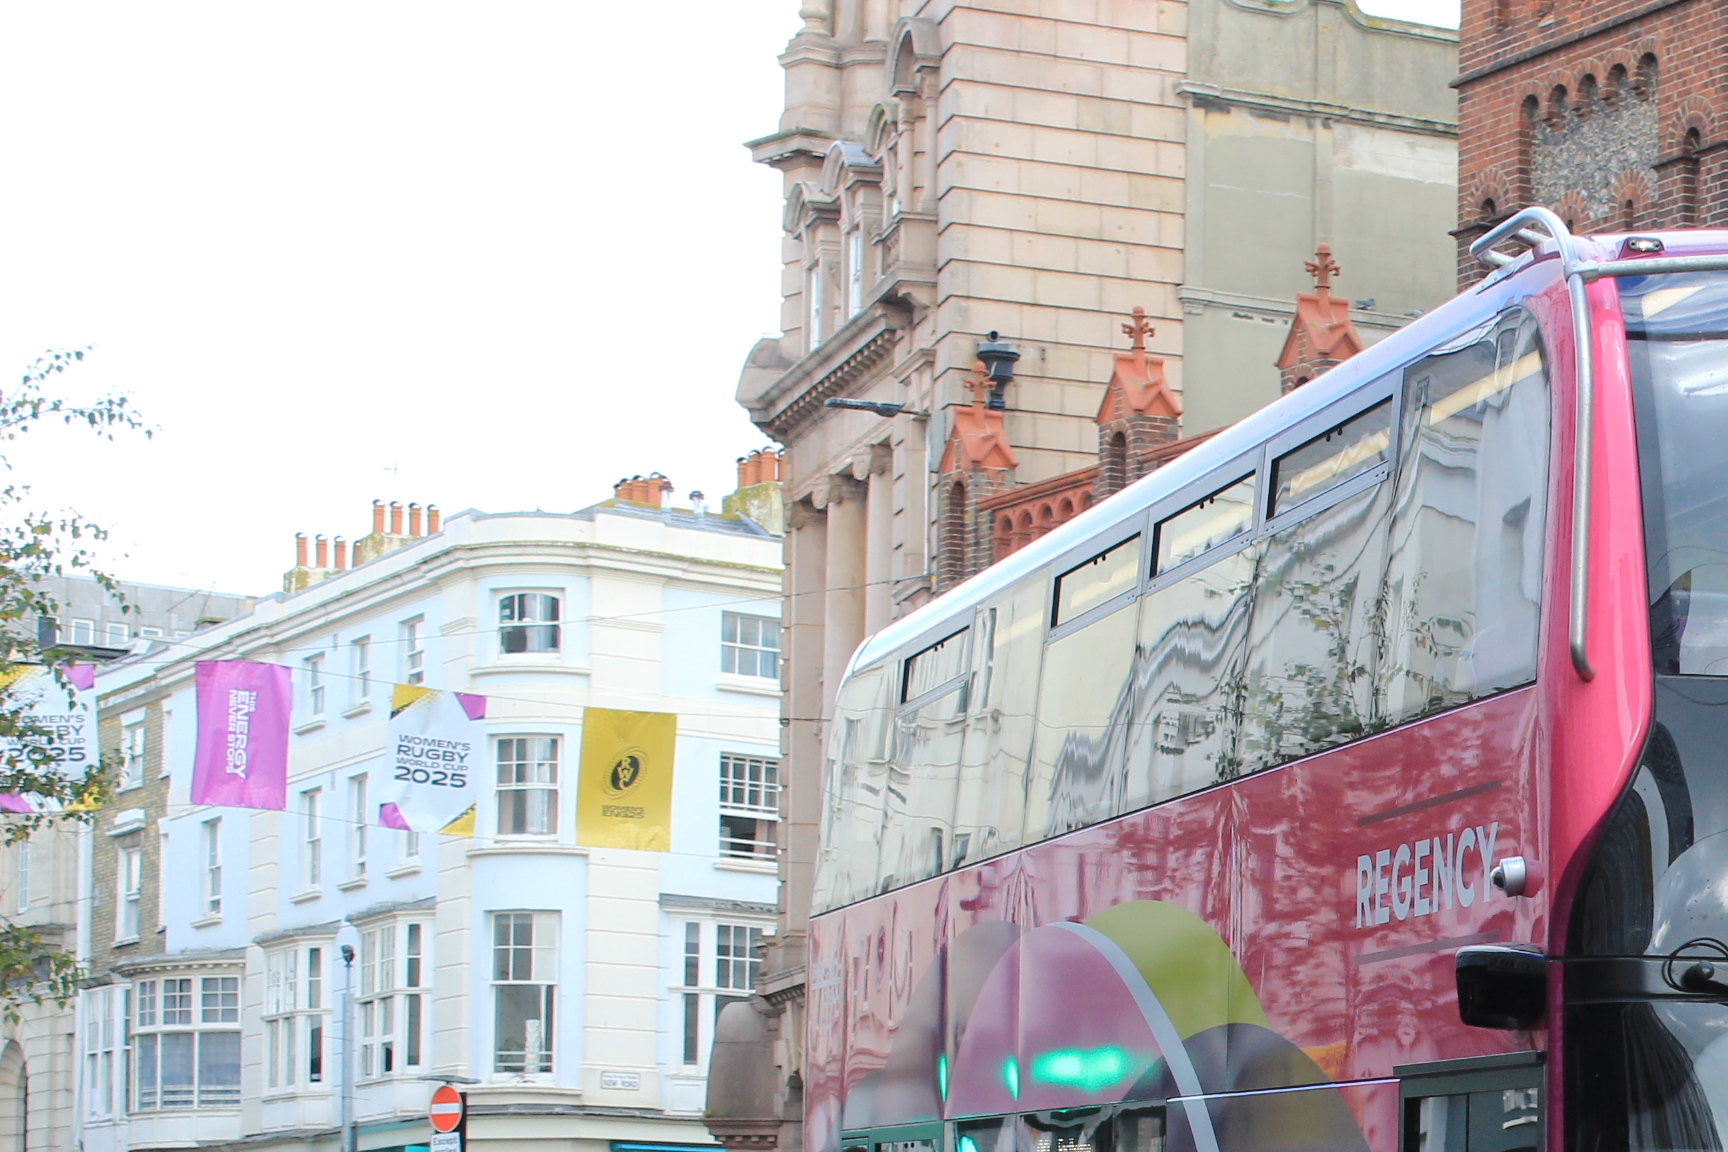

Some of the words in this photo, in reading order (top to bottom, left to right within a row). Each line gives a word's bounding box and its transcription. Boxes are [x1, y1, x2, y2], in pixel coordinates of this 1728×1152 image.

[228, 689, 238, 732] NEVER
[235, 690, 250, 779] ENERGY
[399, 734, 471, 751] WOMEN'S
[397, 744, 469, 763] RUGBY
[396, 757, 440, 768] WORLD
[443, 763, 469, 772] CUP
[394, 766, 467, 788] 2025
[1356, 821, 1499, 930] REGENCY
[432, 1136, 458, 1147] Except
